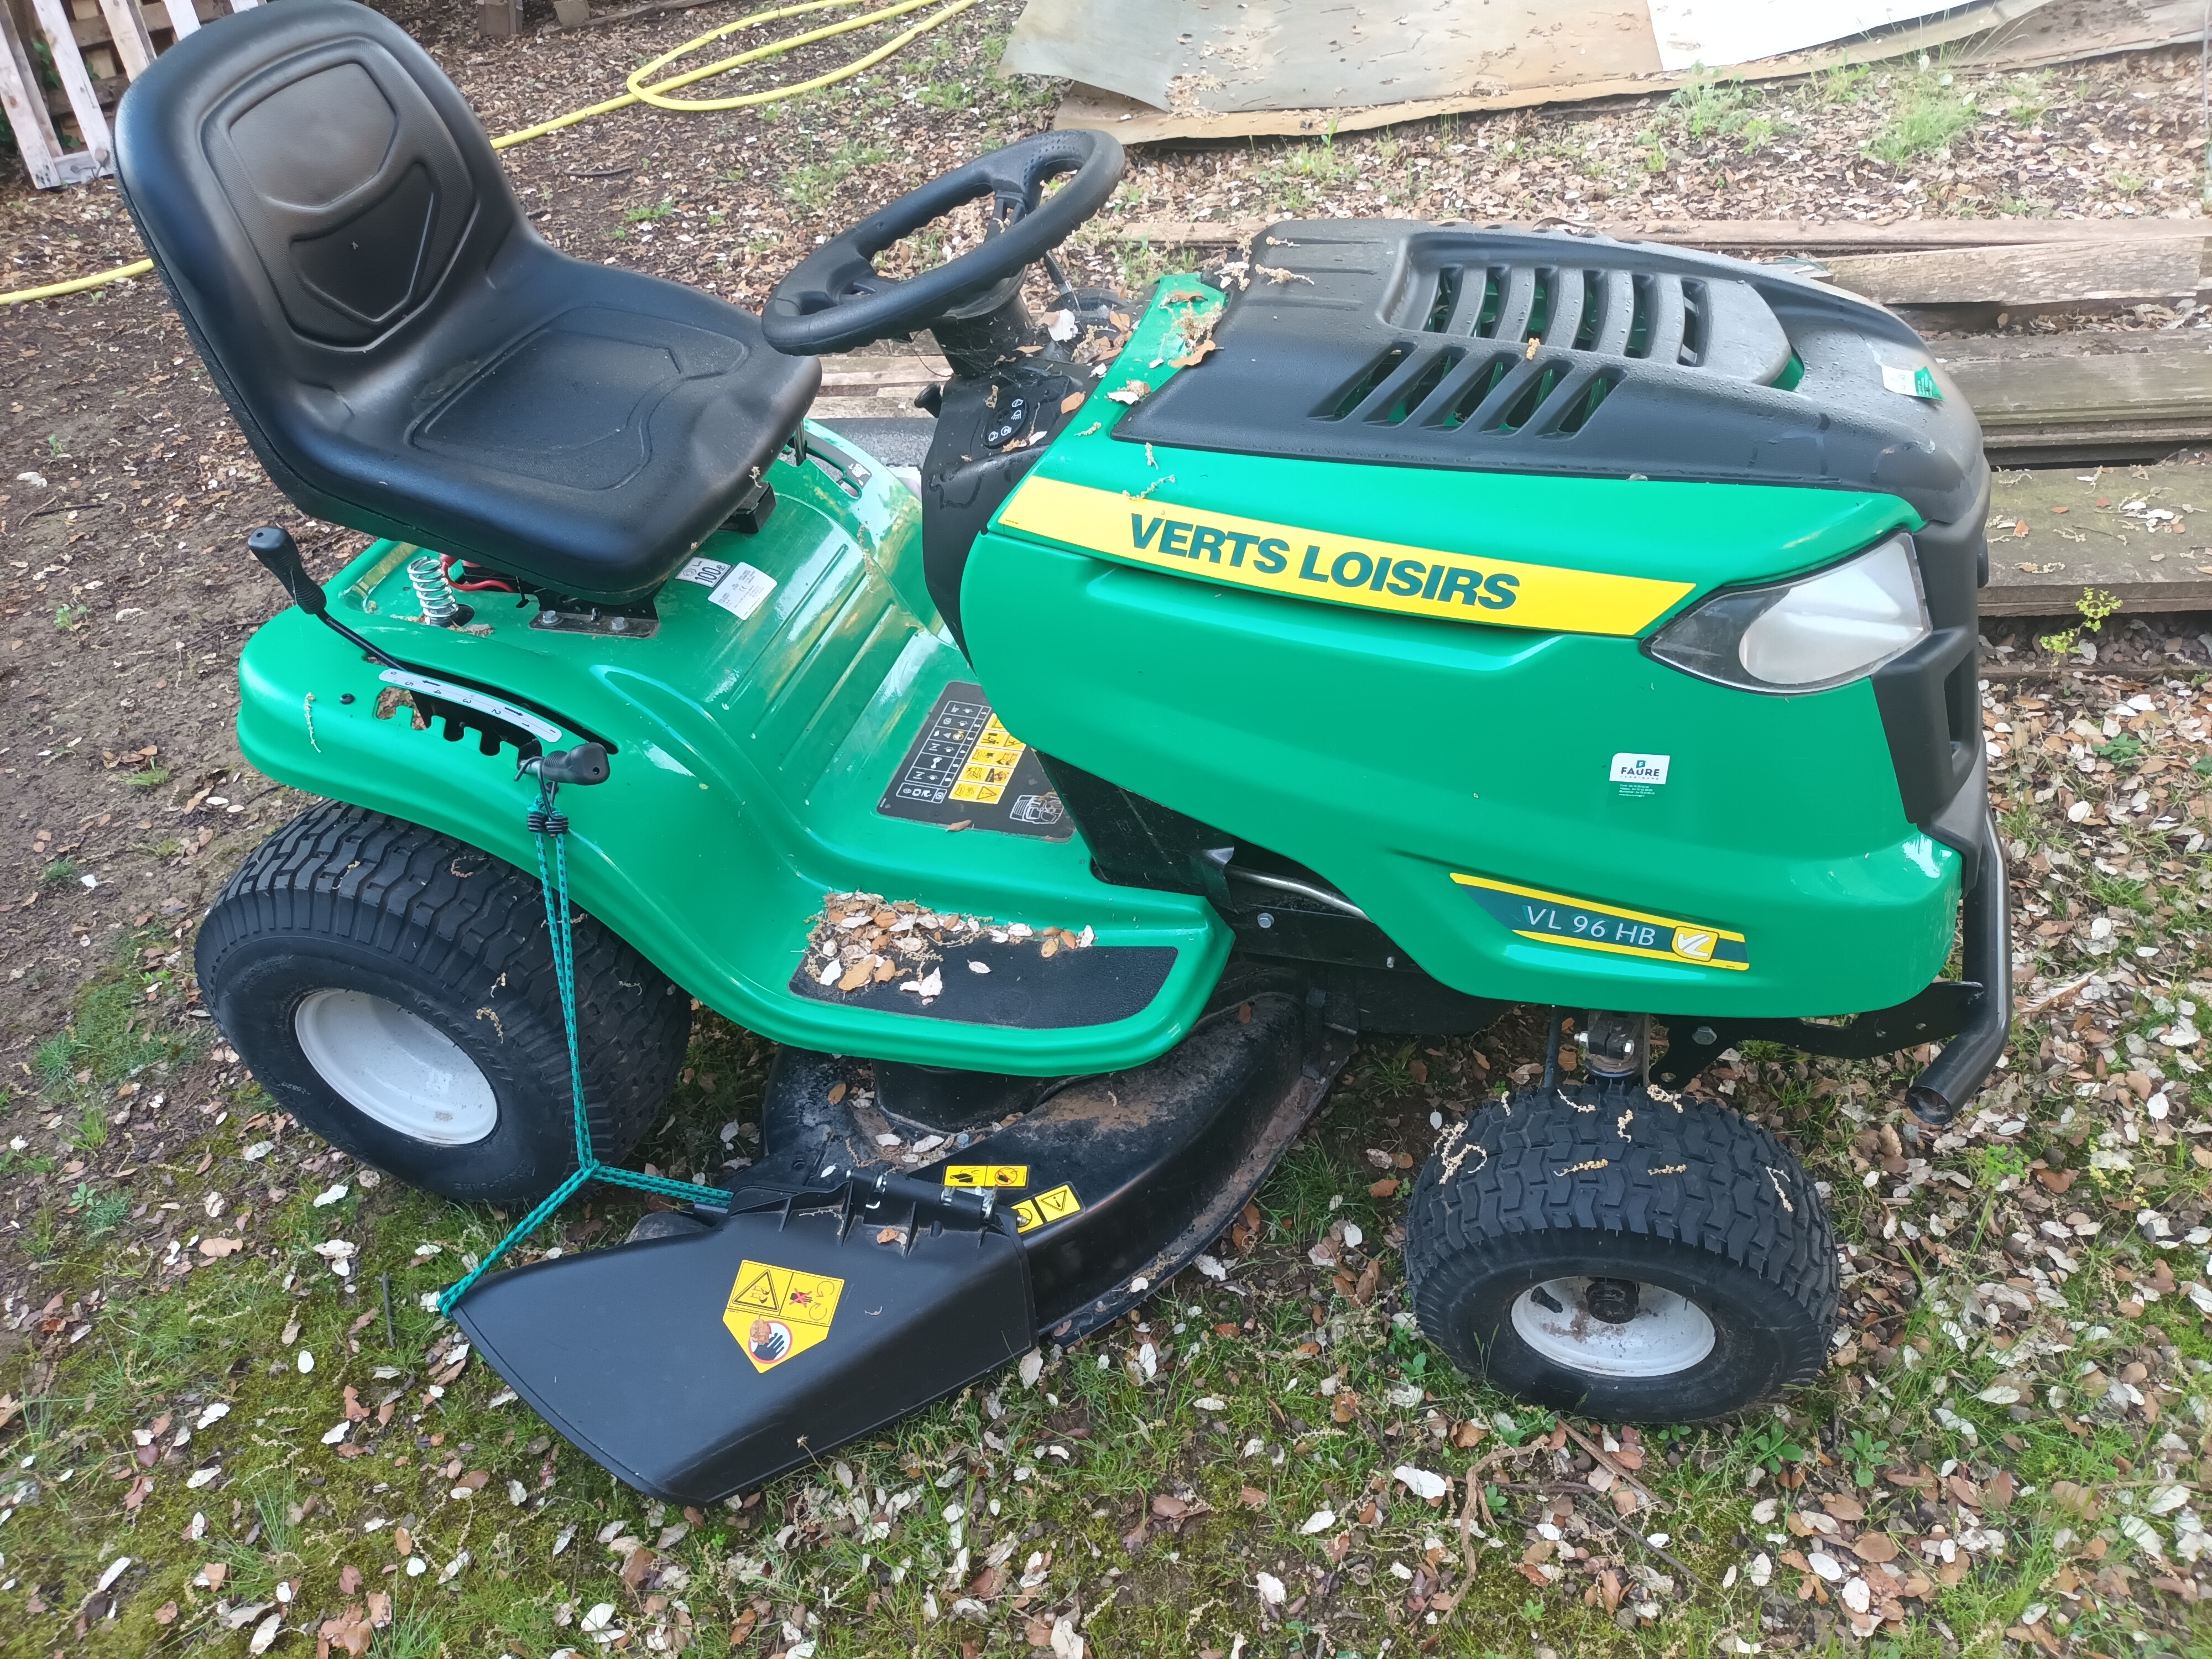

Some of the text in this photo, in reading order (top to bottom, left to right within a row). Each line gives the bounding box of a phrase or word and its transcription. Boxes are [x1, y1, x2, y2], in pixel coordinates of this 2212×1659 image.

[695, 567, 721, 583] 100
[1130, 513, 1520, 610] VERTS LOISIRS
[1621, 767, 1660, 776] FAURE
[1527, 906, 1656, 946] VL 96 HB
